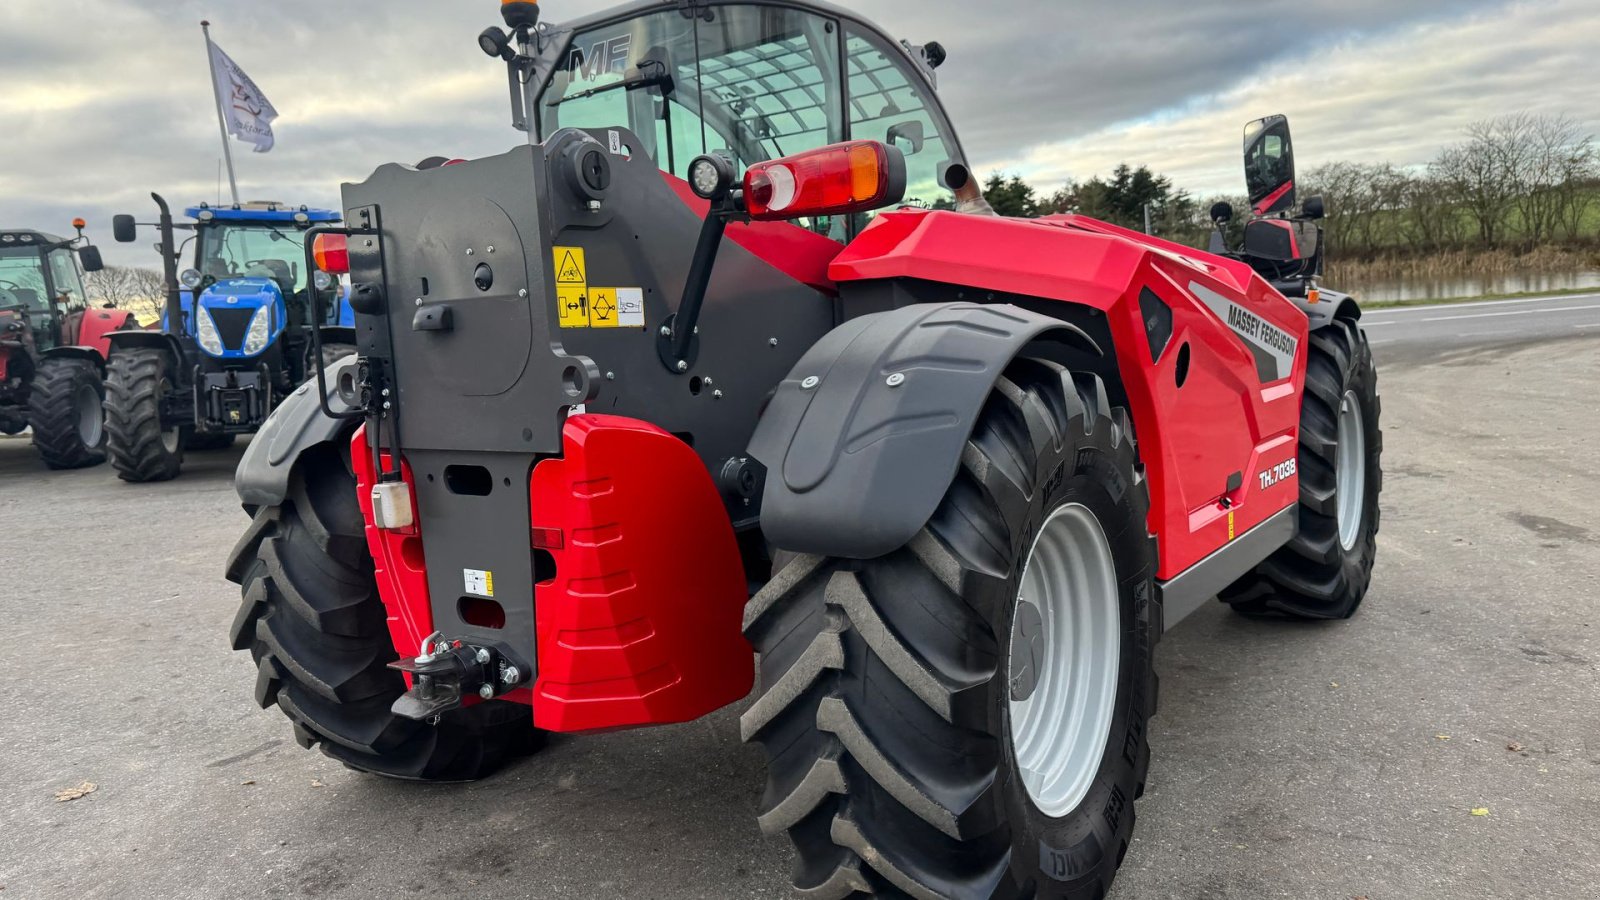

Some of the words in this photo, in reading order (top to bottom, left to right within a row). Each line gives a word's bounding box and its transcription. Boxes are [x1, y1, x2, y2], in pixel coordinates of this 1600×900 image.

[568, 33, 632, 84] MF
[1228, 304, 1261, 338] MASSEY
[1260, 323, 1296, 357] FERGUSON
[1259, 457, 1296, 491] TH.7038
